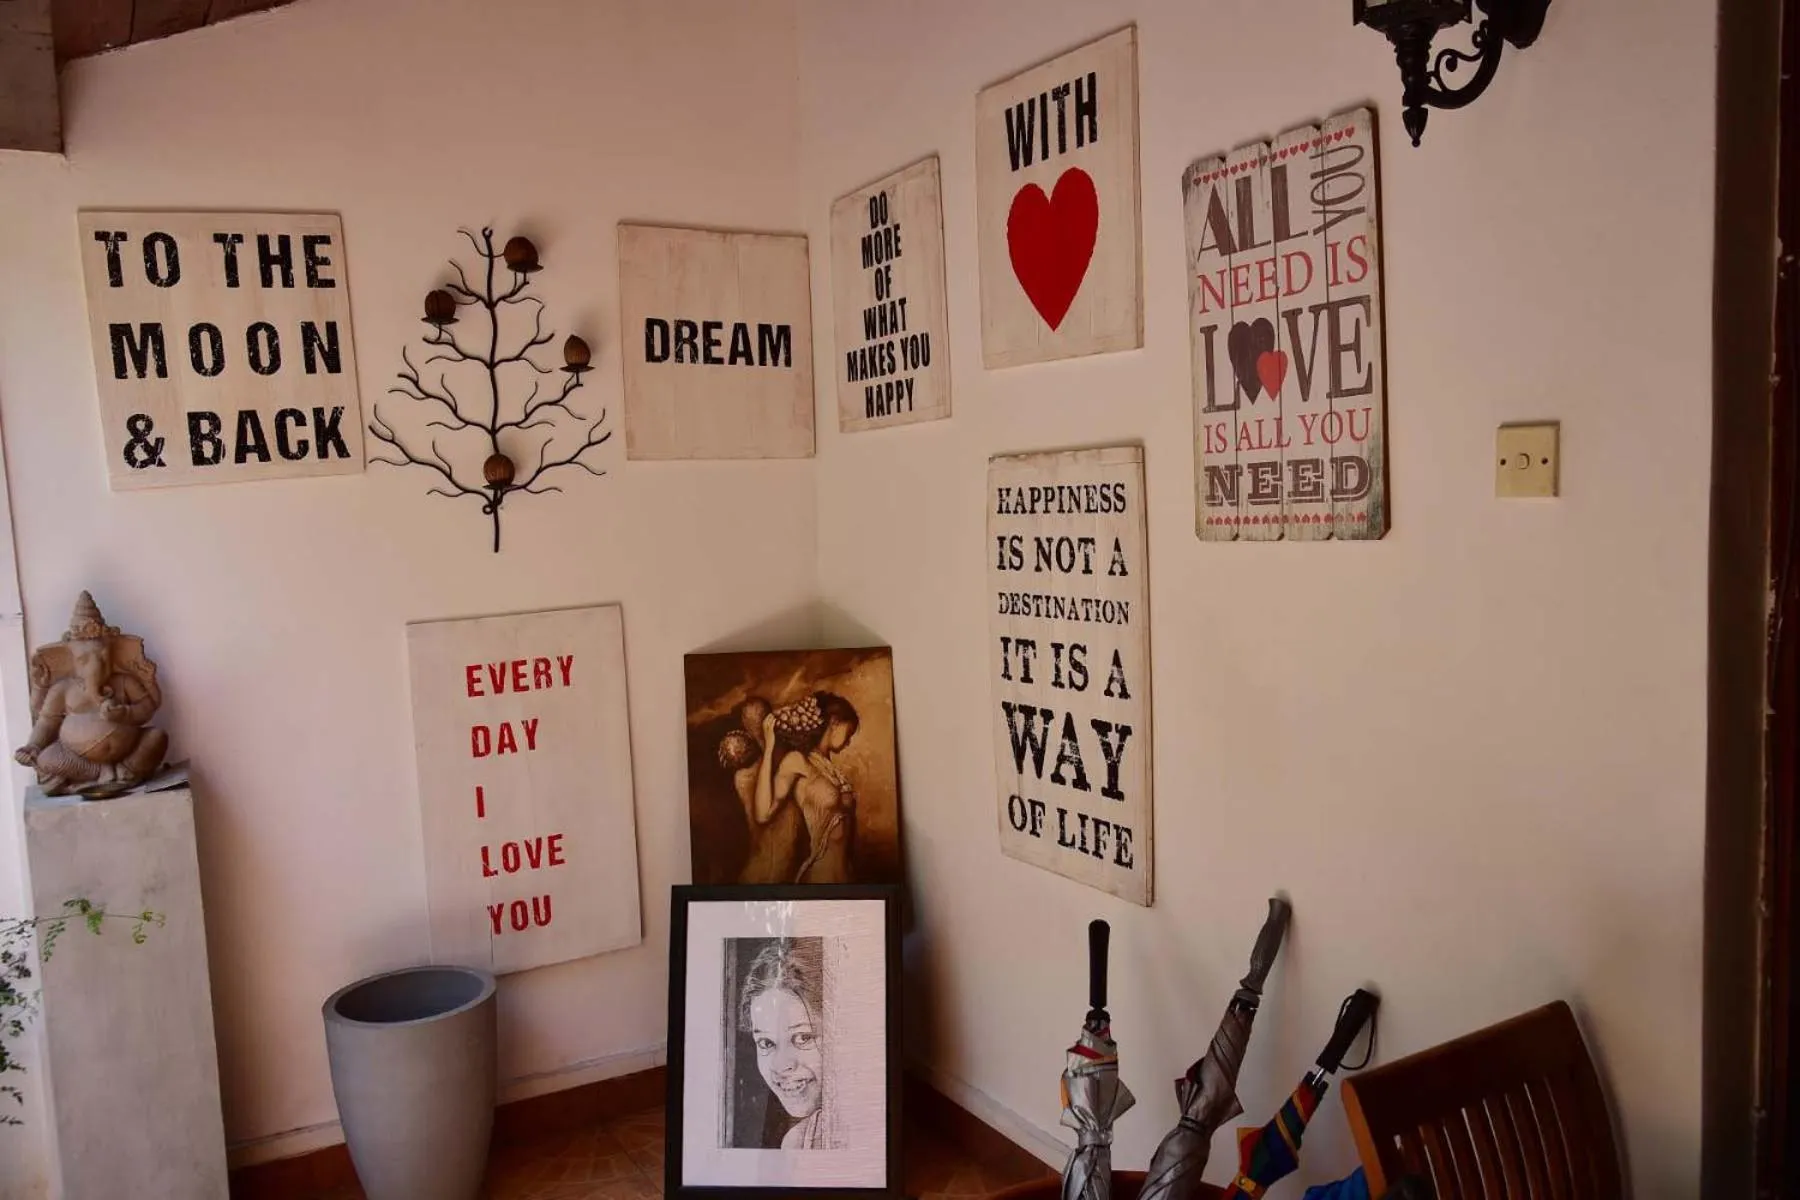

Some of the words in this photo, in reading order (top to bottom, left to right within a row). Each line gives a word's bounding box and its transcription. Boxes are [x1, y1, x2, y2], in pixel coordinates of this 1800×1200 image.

[1005, 72, 1097, 172] WITH
[869, 190, 888, 229] DO
[1198, 164, 1308, 262] ALL
[1309, 145, 1365, 236] YOU
[95, 231, 180, 288] TO
[213, 233, 336, 288] THE
[862, 223, 902, 269] MORE
[874, 265, 892, 301] OF
[1197, 250, 1313, 314] NEED
[1327, 235, 1368, 287] IS
[863, 297, 907, 340] WHAT
[109, 321, 342, 379] MOON
[644, 317, 792, 367] DREAM
[847, 341, 897, 382] MAKES
[901, 332, 930, 371] YOU
[865, 377, 914, 418] HAPPY
[123, 413, 166, 468] &
[187, 405, 351, 467] BACK
[1204, 422, 1227, 454] IS
[1236, 417, 1291, 451] ALL
[1298, 408, 1372, 445] YOU
[997, 483, 1126, 514] HAPPINESS
[1204, 456, 1373, 507] NEED
[997, 535, 1024, 572] IS
[1034, 536, 1095, 575] NOT
[1107, 537, 1128, 577] A
[998, 592, 1130, 625] DESTINATION
[465, 655, 574, 698] EVERY
[1000, 636, 1037, 685] IT
[1051, 642, 1089, 691] IS
[1104, 649, 1131, 700] A
[471, 719, 539, 758] DAY
[1002, 701, 1132, 801] WAY
[475, 786, 485, 818] I
[1009, 794, 1046, 838] OF
[1056, 807, 1134, 870] LIFE
[480, 833, 565, 878] LOVE
[487, 895, 552, 935] YOU
